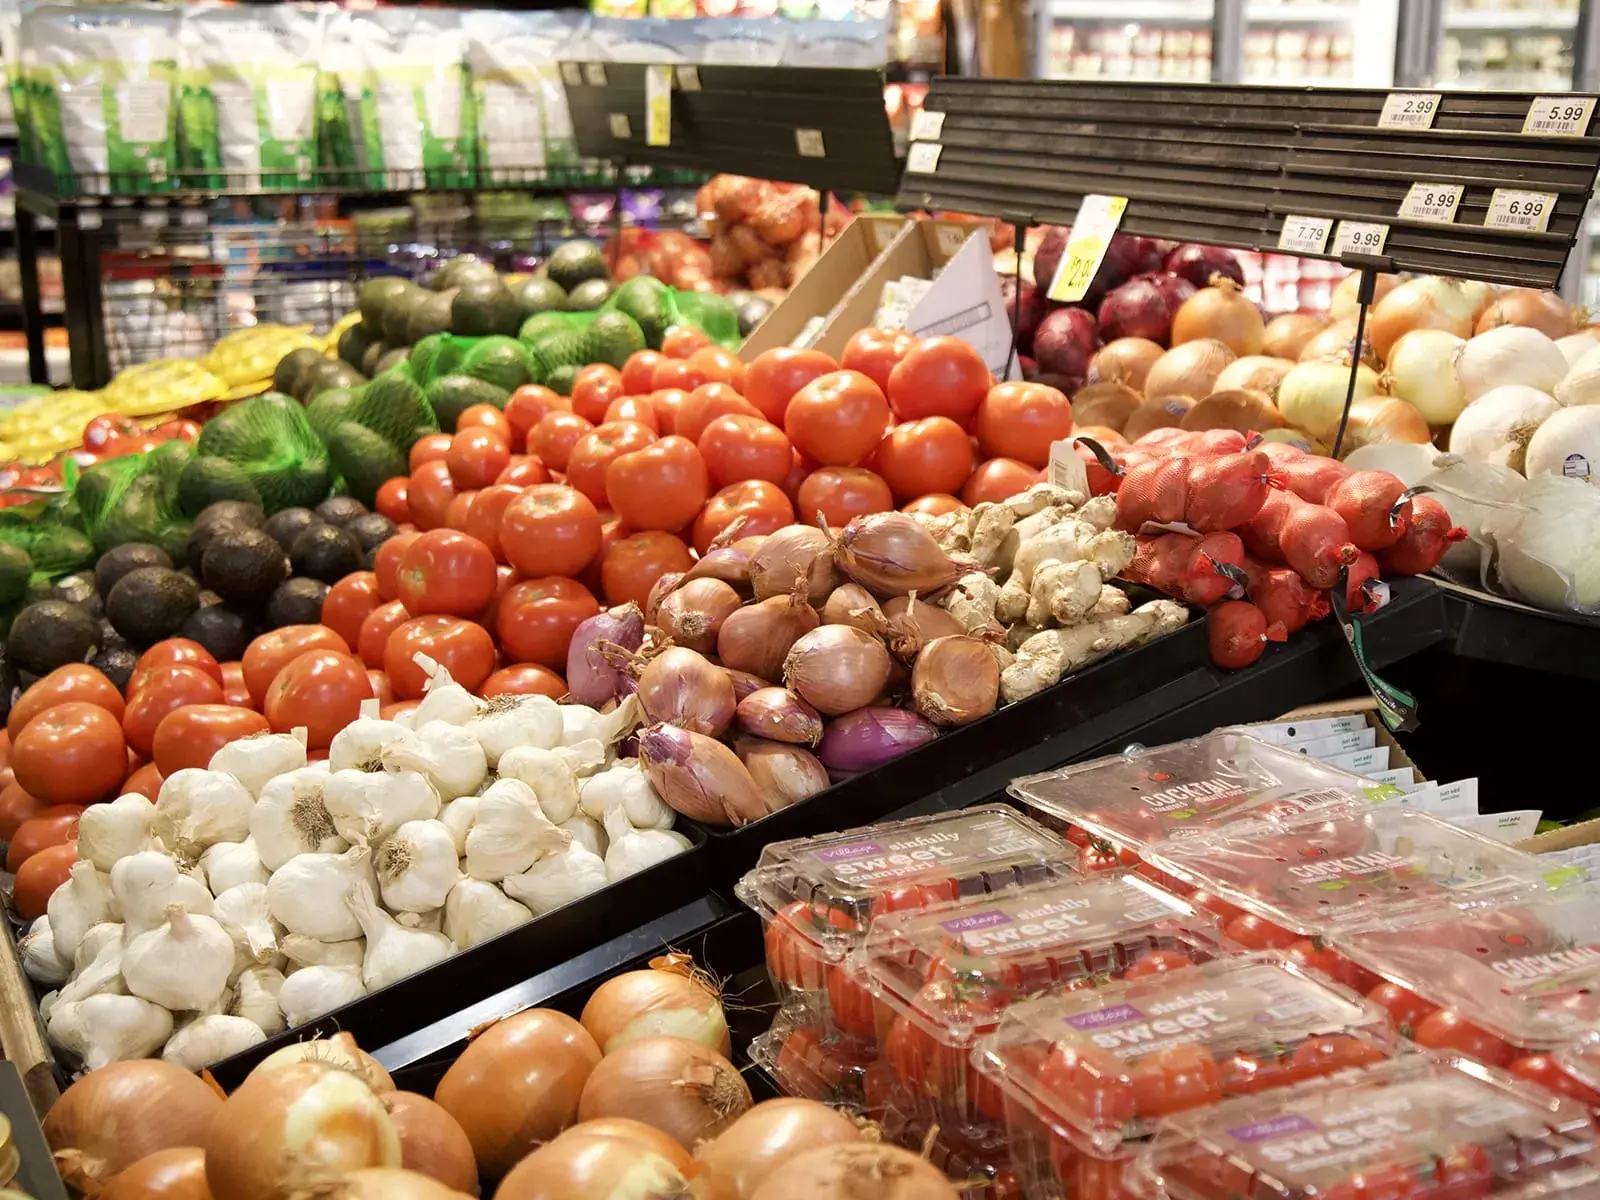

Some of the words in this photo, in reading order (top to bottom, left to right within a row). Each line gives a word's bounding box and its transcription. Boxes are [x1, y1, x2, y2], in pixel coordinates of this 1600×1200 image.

[1403, 100, 1433, 113] 2.99
[1548, 106, 1583, 121] 5.99
[1424, 193, 1455, 208] 8.99
[1509, 200, 1543, 217] 6.99
[1298, 226, 1324, 241] 7.79
[1352, 232, 1381, 247] 9.99
[1140, 777, 1242, 808] COCKTAIL
[889, 831, 960, 852] sinfully
[834, 844, 953, 875] sweet
[1288, 850, 1404, 879] COCKTAIL
[1017, 896, 1092, 921] sinfully
[962, 911, 1088, 948] sweet
[1091, 1004, 1228, 1049] sweet
